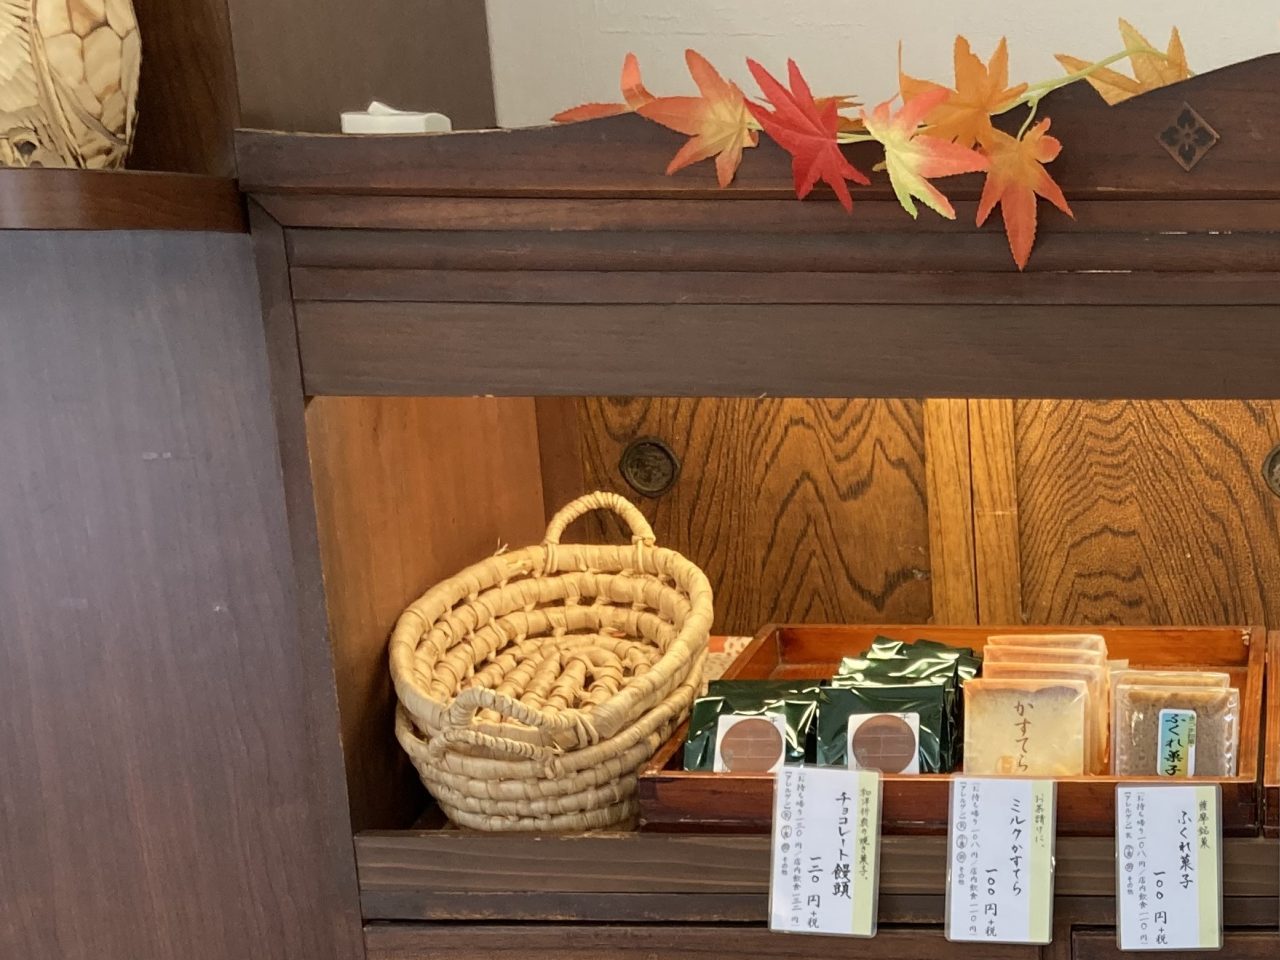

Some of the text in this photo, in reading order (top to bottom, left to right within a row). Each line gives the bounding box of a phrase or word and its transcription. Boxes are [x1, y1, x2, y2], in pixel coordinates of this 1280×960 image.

[1014, 700, 1034, 772] かすてら
[1164, 713, 1186, 776] ふくれ菓子
[832, 792, 853, 900] チョコレート饅頭
[1010, 798, 1027, 897] ミルクかすてら
[1177, 810, 1194, 890] ふくれ菓子
[1198, 799, 1210, 849] 薩摩銘菓
